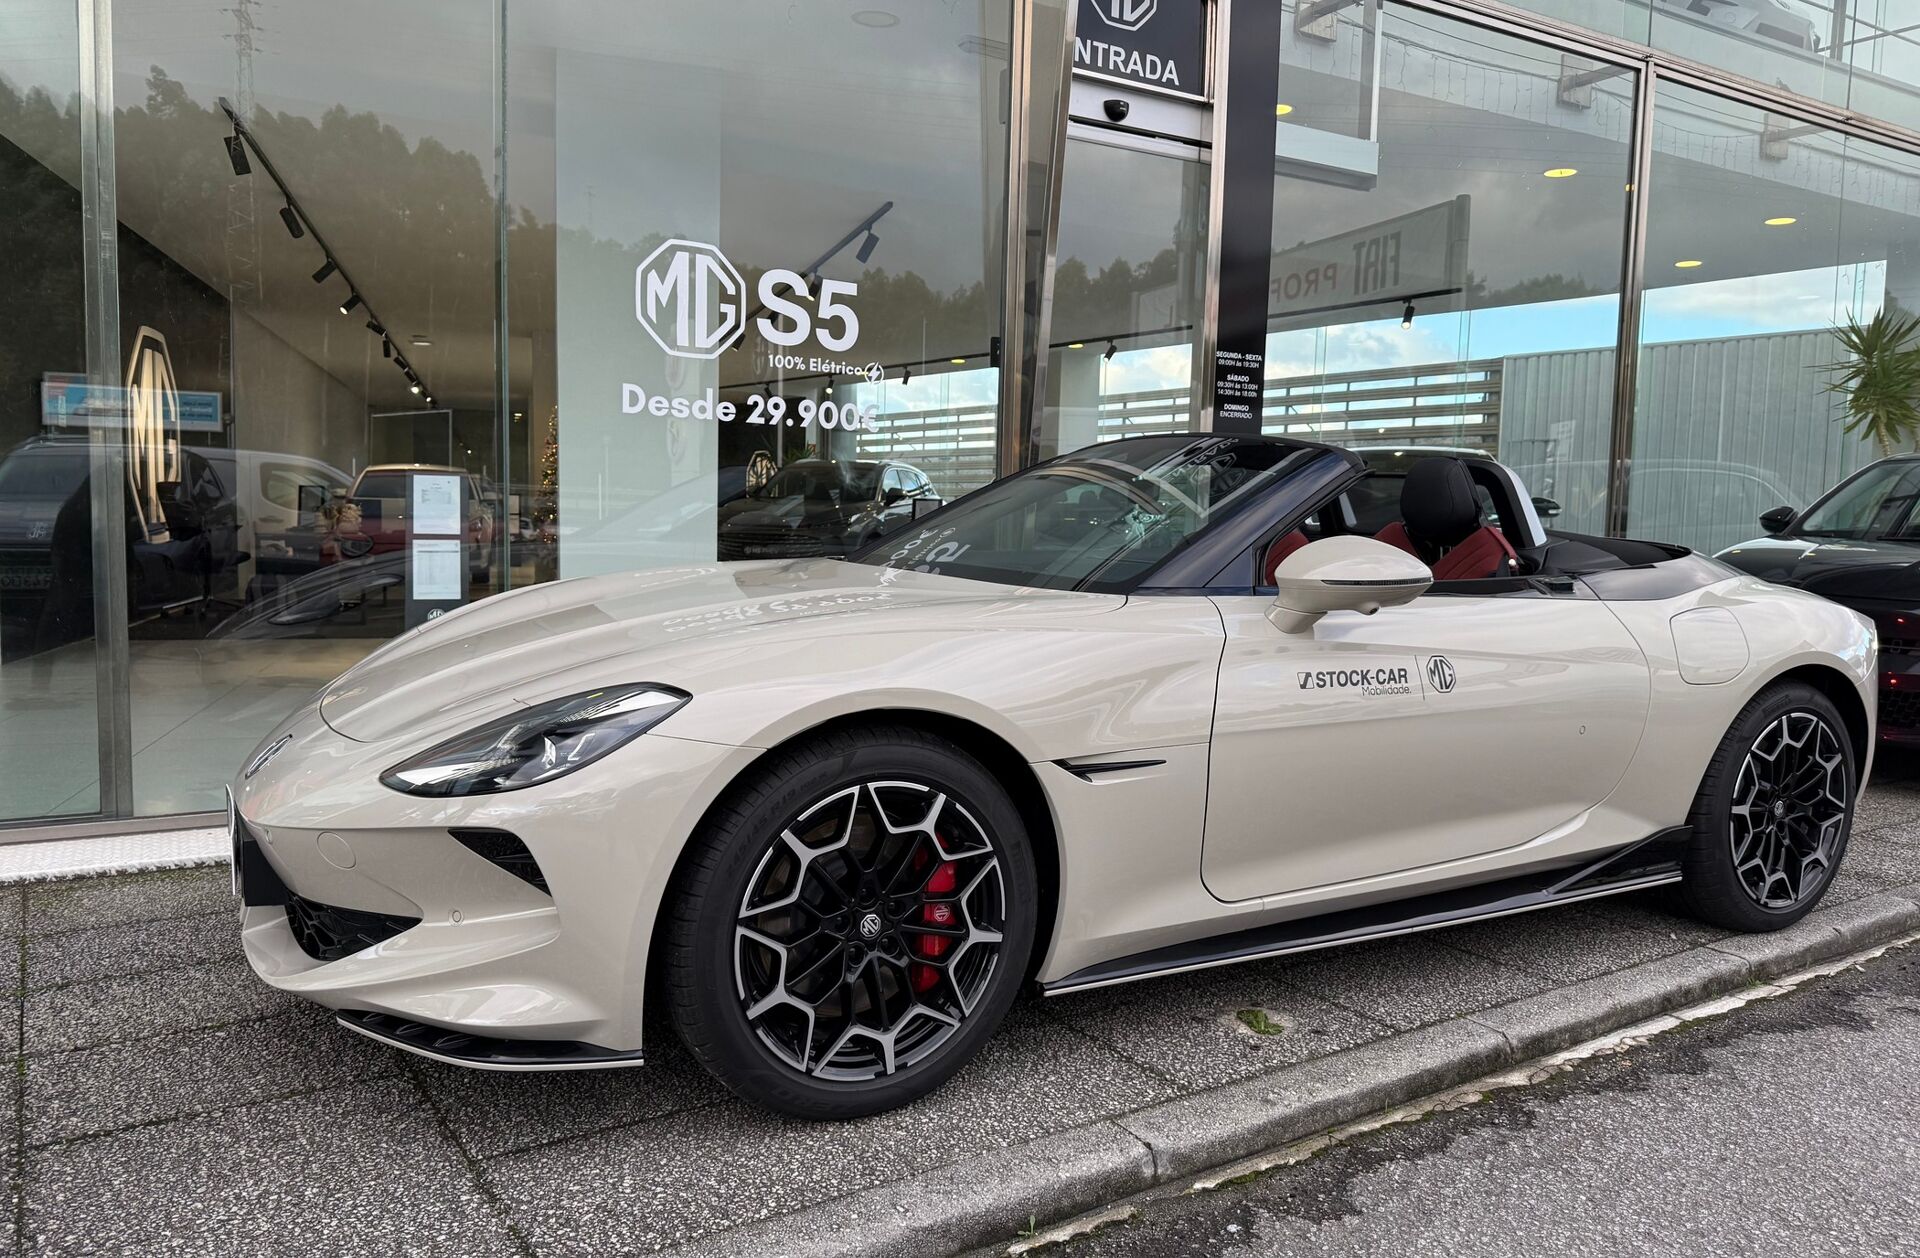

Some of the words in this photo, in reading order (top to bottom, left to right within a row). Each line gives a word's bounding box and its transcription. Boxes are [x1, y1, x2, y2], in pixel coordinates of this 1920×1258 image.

[1074, 36, 1179, 86] NTRADA
[646, 250, 737, 348] MG
[757, 269, 859, 352] S5
[768, 354, 806, 371] 100%
[809, 357, 863, 375] Elétrico
[1216, 351, 1242, 359] SEGUNDA
[1245, 354, 1262, 362] SEXTA
[1227, 373, 1250, 382] SÁBADO
[622, 383, 737, 422] Desde
[746, 394, 880, 433] 29.900€
[1220, 410, 1253, 419] ENCERRADO
[1224, 403, 1250, 411] DOMINGO
[1316, 668, 1408, 688] STOCK-CAR
[1428, 658, 1454, 691] MG
[1361, 684, 1412, 697] Mobilidade.
[861, 915, 880, 936] MG
